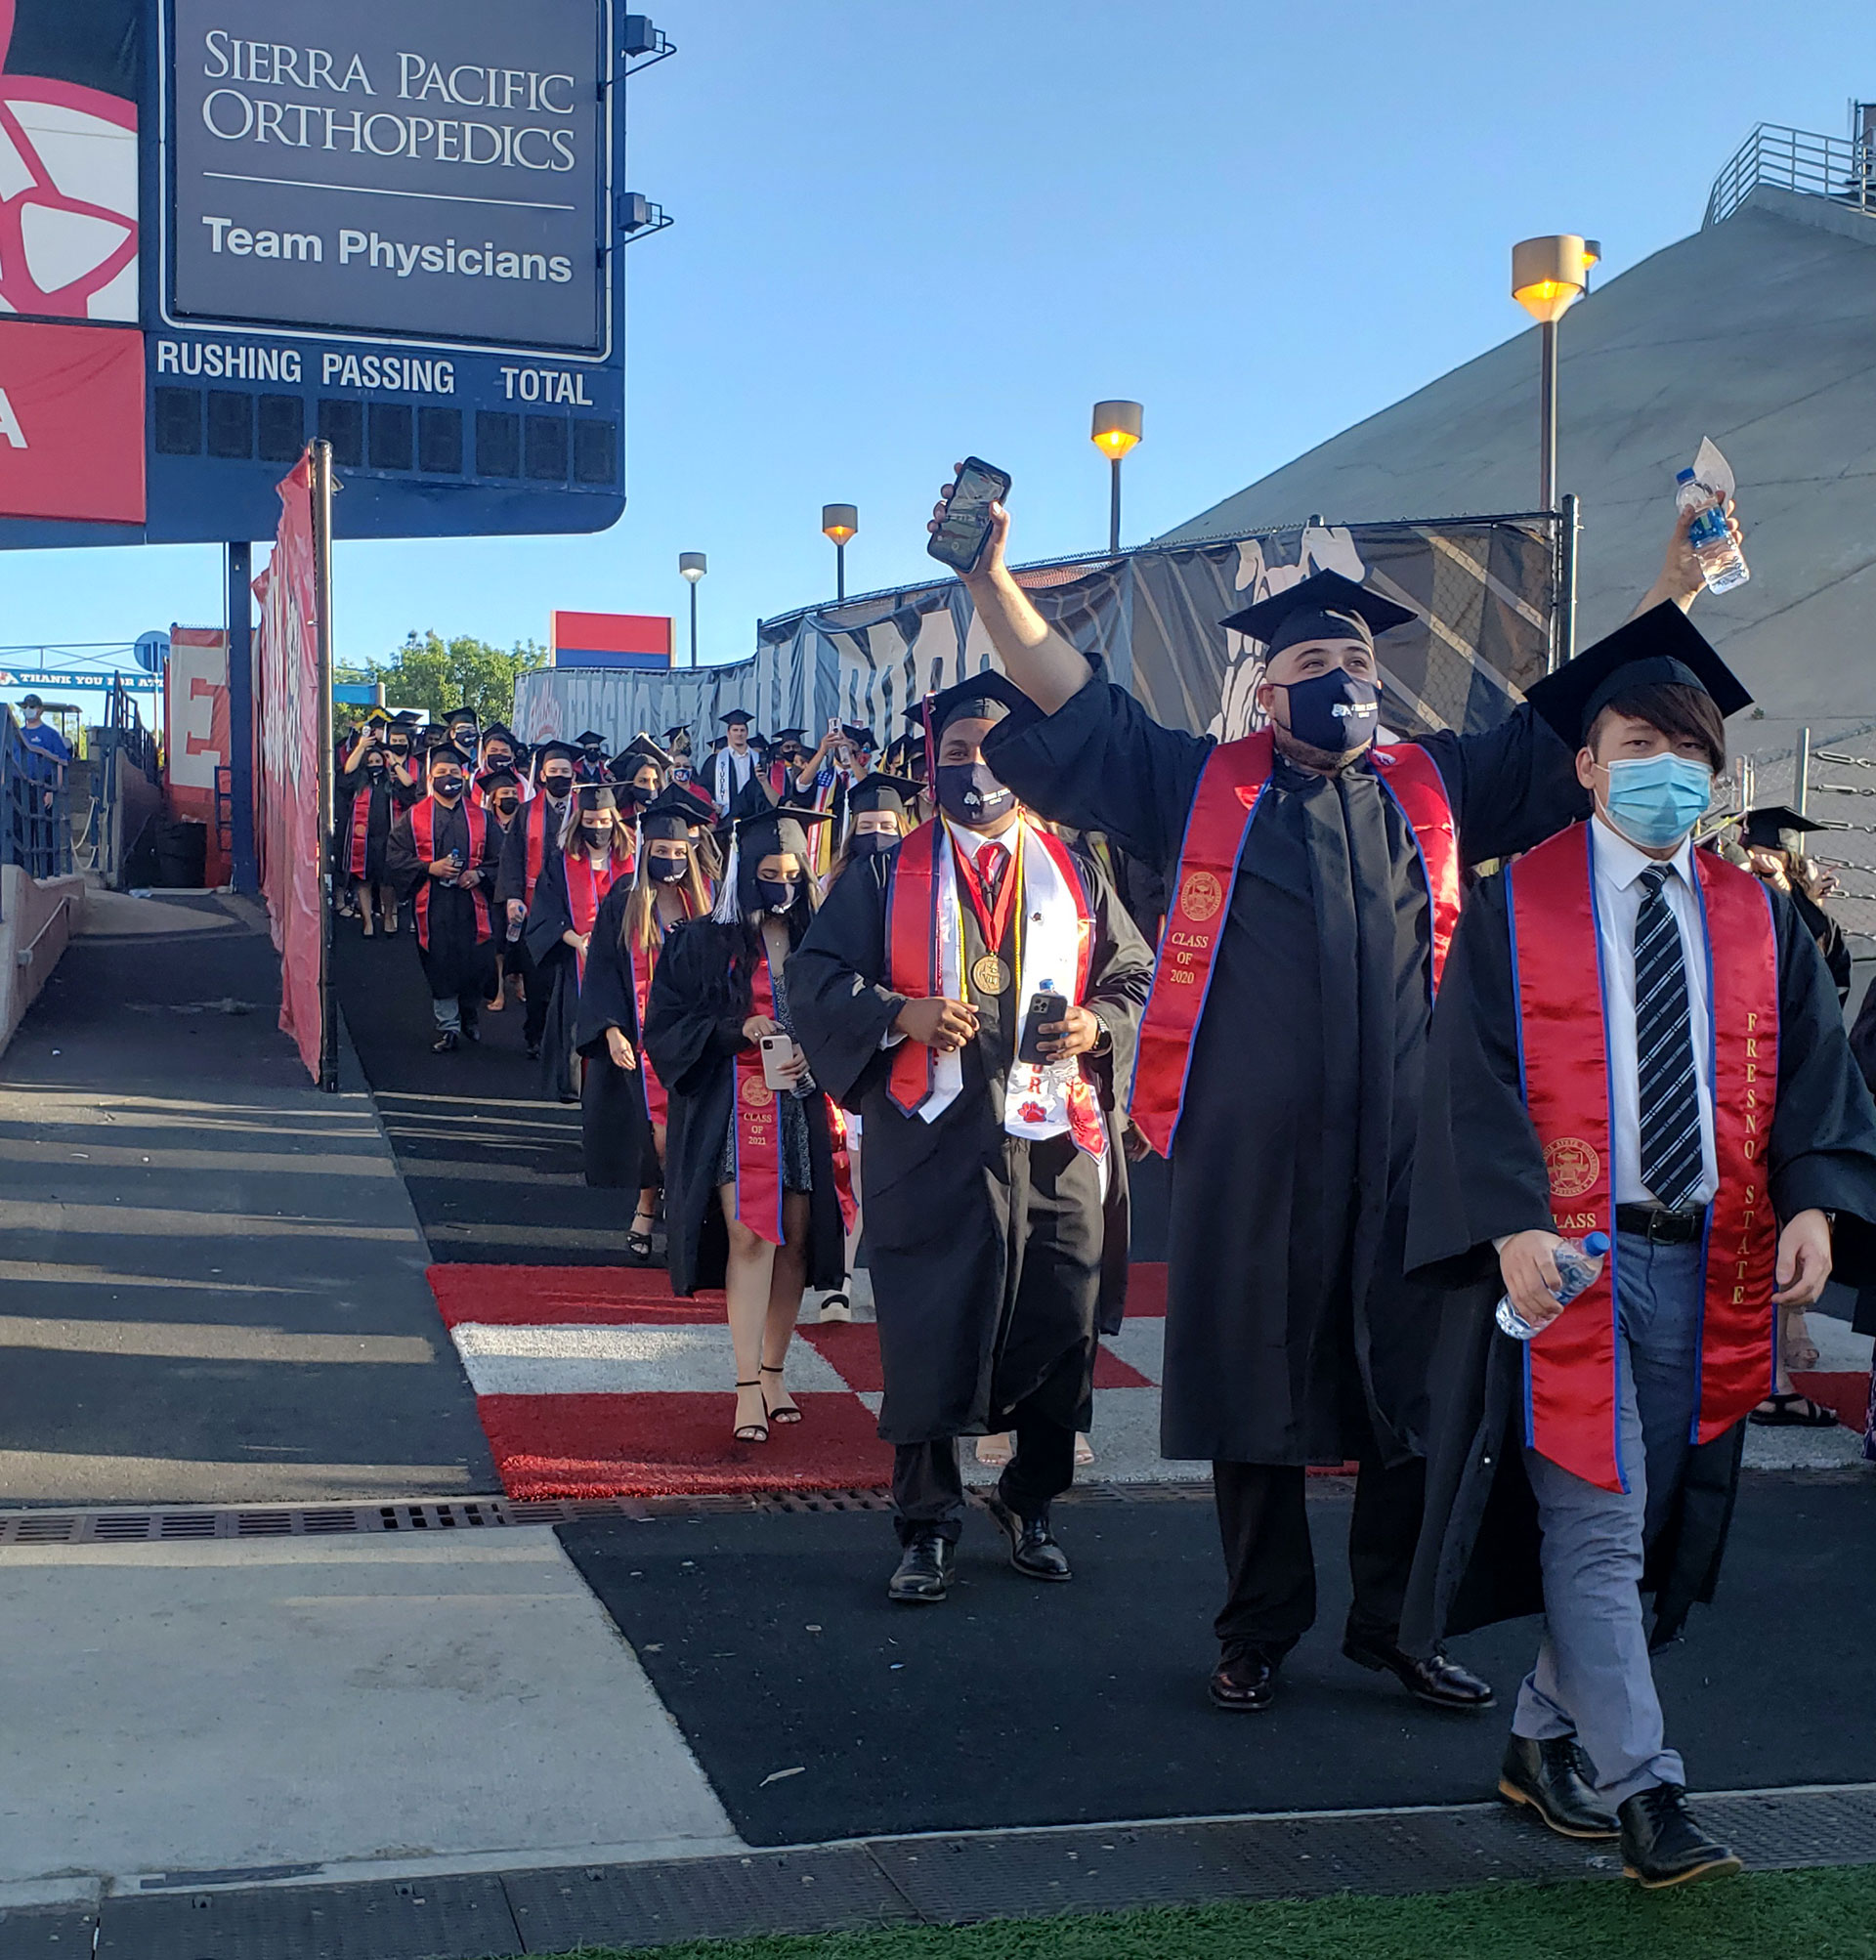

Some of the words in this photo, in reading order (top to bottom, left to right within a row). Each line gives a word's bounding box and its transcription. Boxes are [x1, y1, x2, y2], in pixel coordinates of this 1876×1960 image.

[203, 29, 377, 96] SIERRA
[396, 51, 576, 114] PACIFIC
[202, 88, 576, 172] ORTHOPEDICS
[202, 215, 323, 262] Team
[339, 229, 573, 283] Physicians
[156, 340, 302, 383] RUSHING
[322, 353, 454, 394] PASSING
[499, 366, 594, 406] TOTAL
[20, 673, 71, 685] THANK
[75, 675, 104, 686] YOU
[1172, 931, 1209, 948] CLASS
[1176, 951, 1193, 965] OF
[1170, 968, 1195, 984] 2020
[1744, 1012, 1758, 1160] FRESNO
[744, 1112, 772, 1123] CLASS
[751, 1125, 764, 1134] OF
[747, 1135, 766, 1145] 2021
[1552, 1213, 1597, 1229] LASS
[1731, 1184, 1755, 1305] STATE
